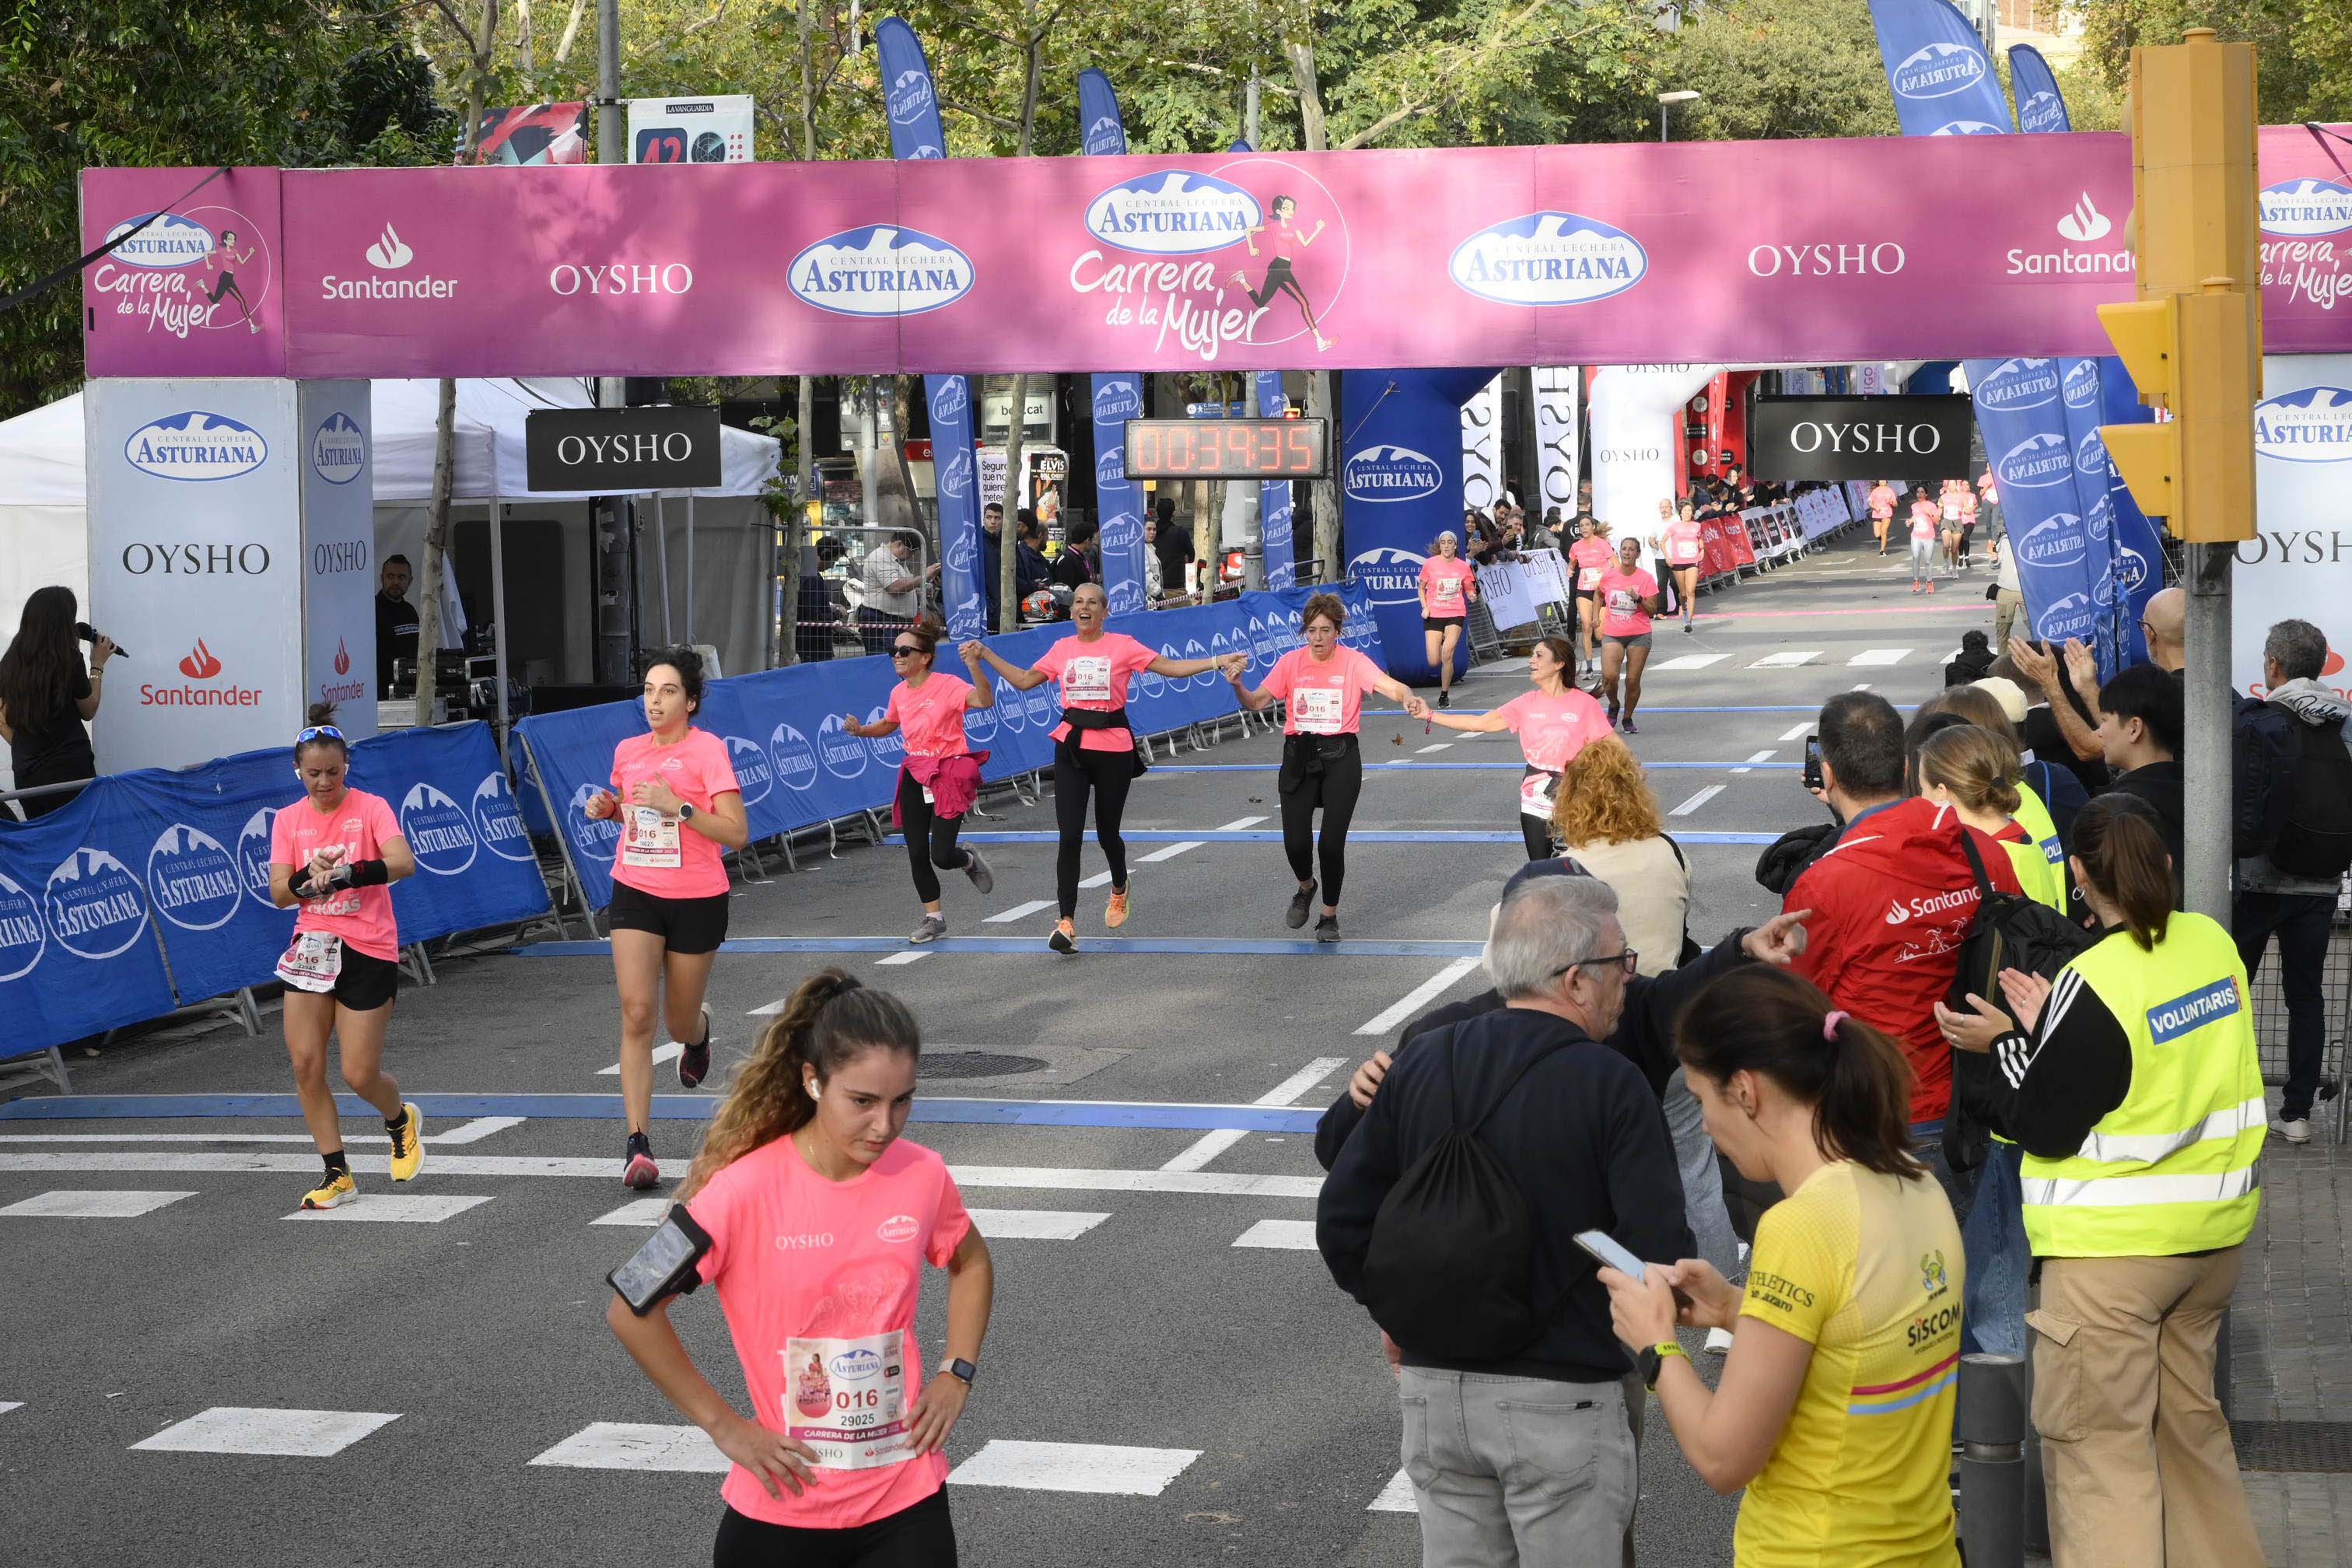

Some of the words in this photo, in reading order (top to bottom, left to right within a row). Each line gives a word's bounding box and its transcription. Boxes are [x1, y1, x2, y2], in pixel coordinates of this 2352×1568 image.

[1125, 197, 1182, 208] CENTRAL
[1187, 197, 1243, 207] LECHERA
[1099, 202, 1248, 235] ASTURIANA
[1562, 242, 1626, 253] LECHERA
[1748, 242, 1906, 276] OYSHO
[2260, 240, 2334, 264] arrera
[830, 255, 891, 266] CENTRAL
[895, 255, 954, 265] LECHERA
[1070, 250, 1216, 294] Carrera
[1466, 248, 1633, 282] ASTURIANA
[94, 264, 186, 293] Carrera
[550, 263, 693, 296] OYSHO
[801, 258, 961, 292] ASTURIANA
[2277, 264, 2292, 285] la
[322, 275, 458, 299] Santander
[117, 294, 135, 314] de
[138, 294, 150, 314] la
[147, 291, 221, 339] Mujer
[1105, 295, 1132, 326] de
[1139, 294, 1159, 326] la
[1154, 288, 1270, 361] Mujer
[558, 432, 692, 465] OYSHO
[1138, 427, 1313, 470] 00:39:35
[1790, 422, 1940, 454] OYSHO
[135, 437, 257, 464] ASTURIANA
[317, 439, 362, 467] ASTURIANA
[1601, 448, 1659, 464] OYSHO
[1041, 460, 1064, 471] ELVIS
[1347, 468, 1435, 489] ASTURIANA
[122, 544, 270, 575] OYSHO
[314, 539, 366, 576] OYSHO
[140, 684, 262, 706] Santander
[321, 681, 365, 703] Santander
[776, 751, 815, 776] ASTURIANA
[823, 740, 865, 765] ASTURIANA
[413, 816, 436, 826] CENTRAL
[408, 819, 474, 856] ASTURIANA
[639, 829, 656, 838] 016
[165, 859, 195, 874] CENTRAL
[197, 854, 226, 868] LECHERA
[62, 888, 96, 901] CENTRAL
[157, 868, 238, 909] ASTURIANA
[54, 891, 142, 937] ASTURIANA
[298, 953, 319, 964] 016
[2151, 987, 2235, 1033] VOLUNTARIS
[776, 1233, 834, 1250] OYSHO
[834, 1361, 879, 1374] ASTURIANA
[836, 1389, 878, 1409] 016
[841, 1413, 875, 1426] 29025
[804, 1430, 842, 1439] CARRERA
[875, 1441, 905, 1457] Santander
